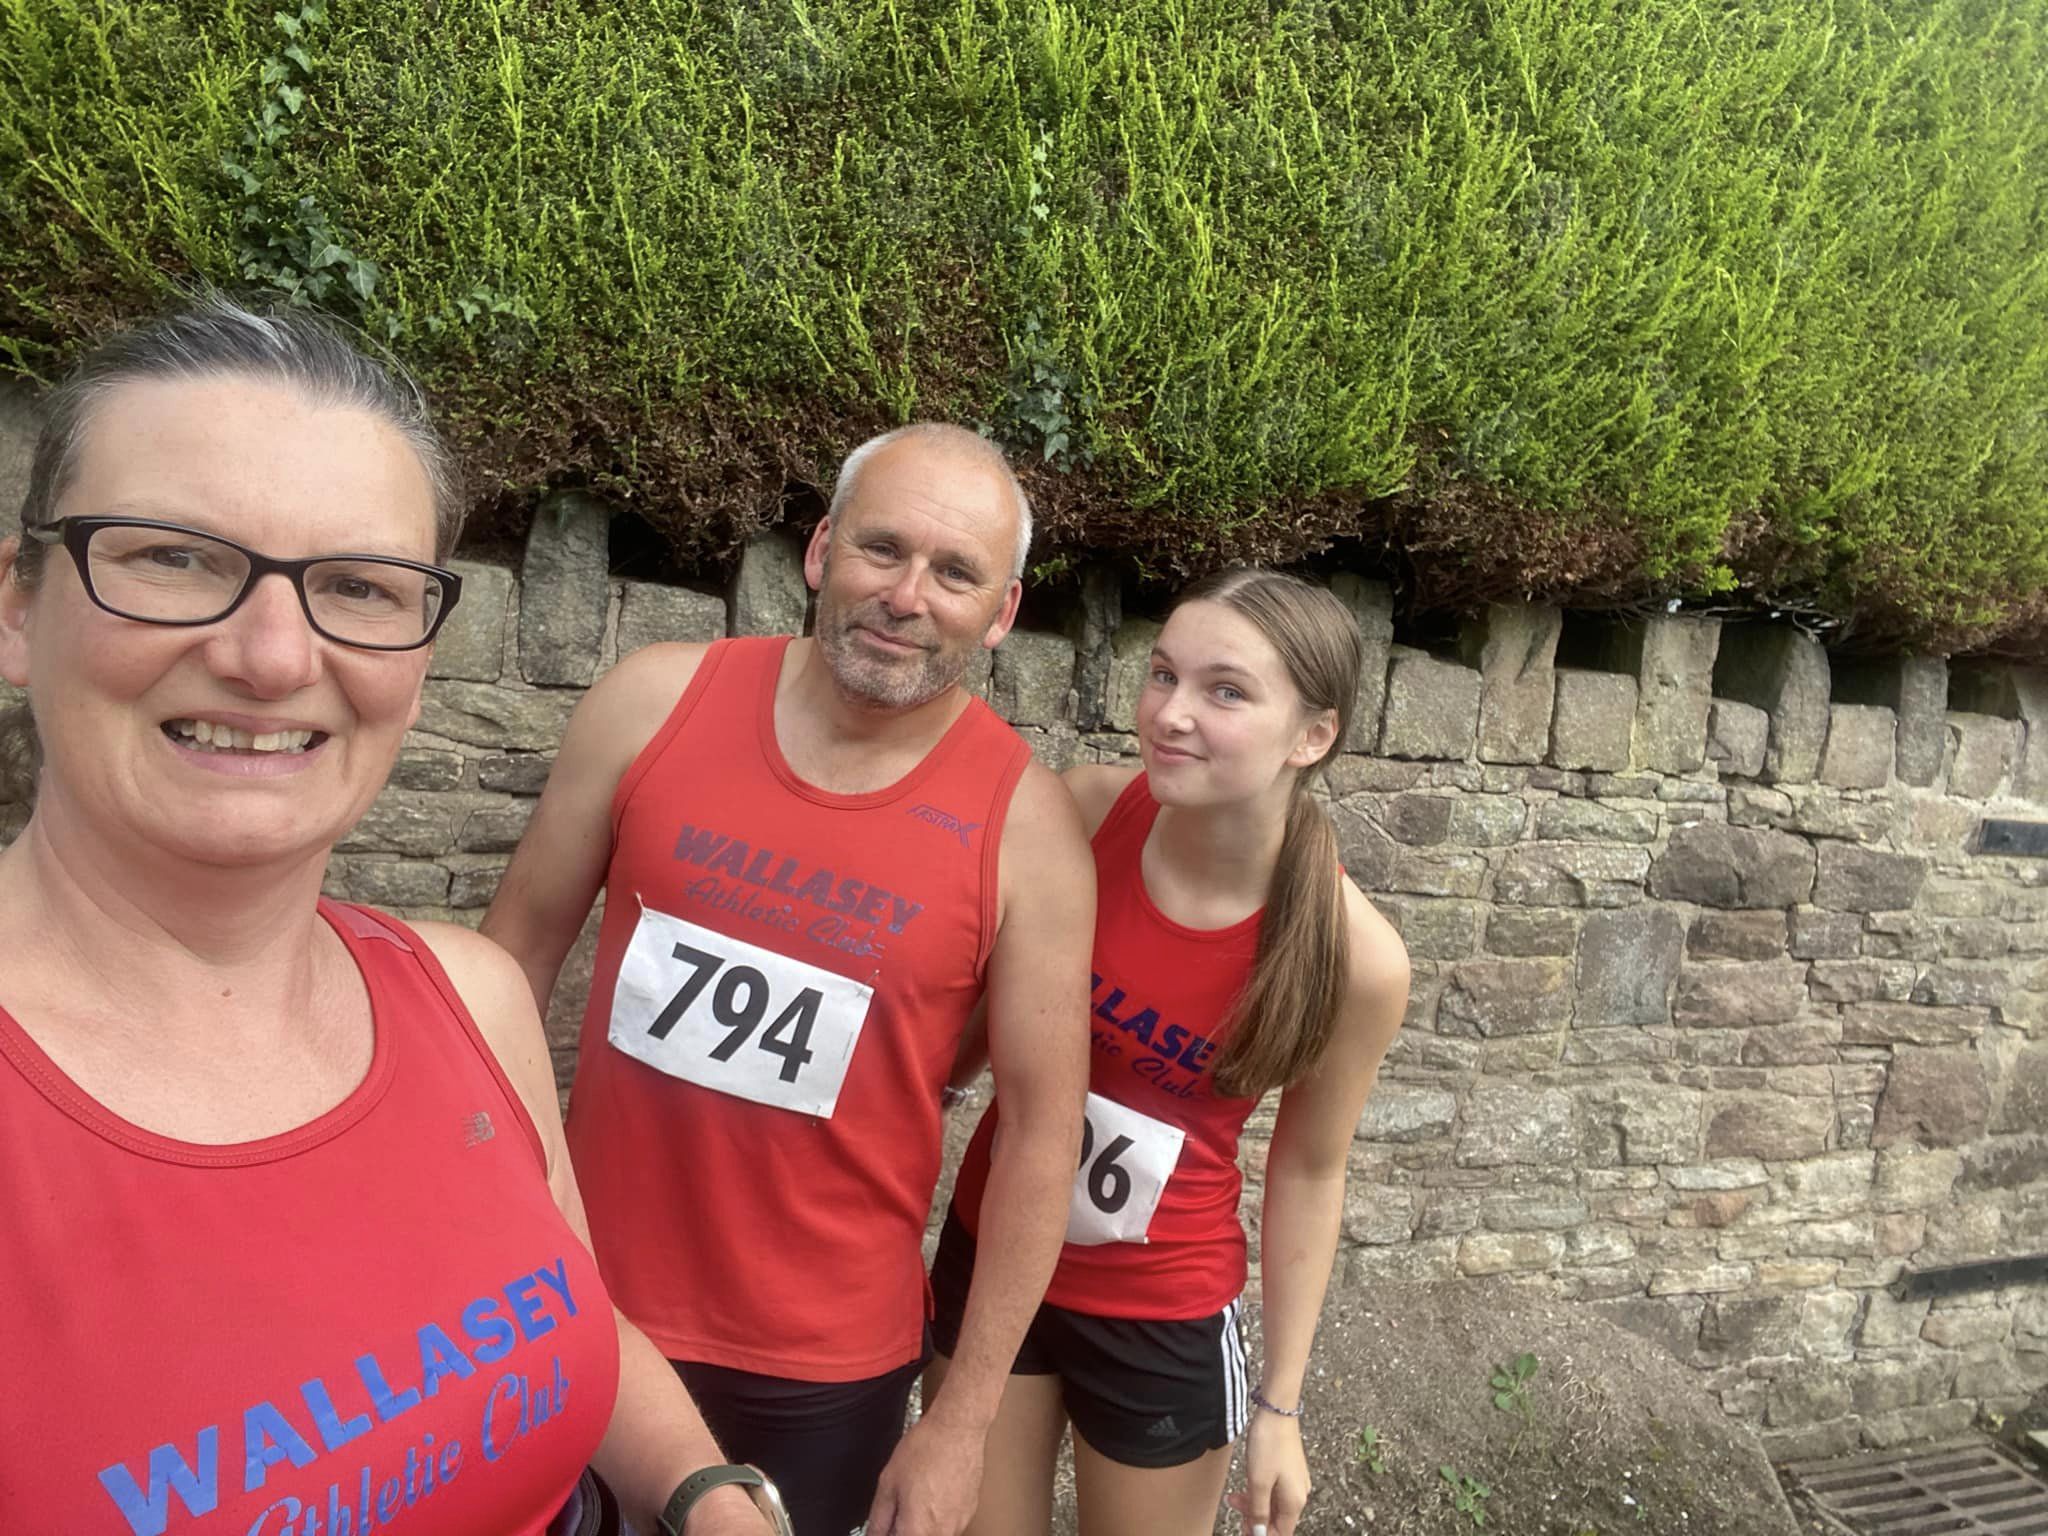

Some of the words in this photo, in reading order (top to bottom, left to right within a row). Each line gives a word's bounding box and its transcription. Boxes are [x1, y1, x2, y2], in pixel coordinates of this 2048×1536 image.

[672, 824, 925, 935] WALLASEY
[684, 876, 799, 932] Athletic
[805, 914, 880, 956] Club
[647, 941, 824, 1084] 794
[1131, 1056, 1200, 1098] Club
[98, 1258, 579, 1536] WALLASEY
[480, 1355, 570, 1463] Club
